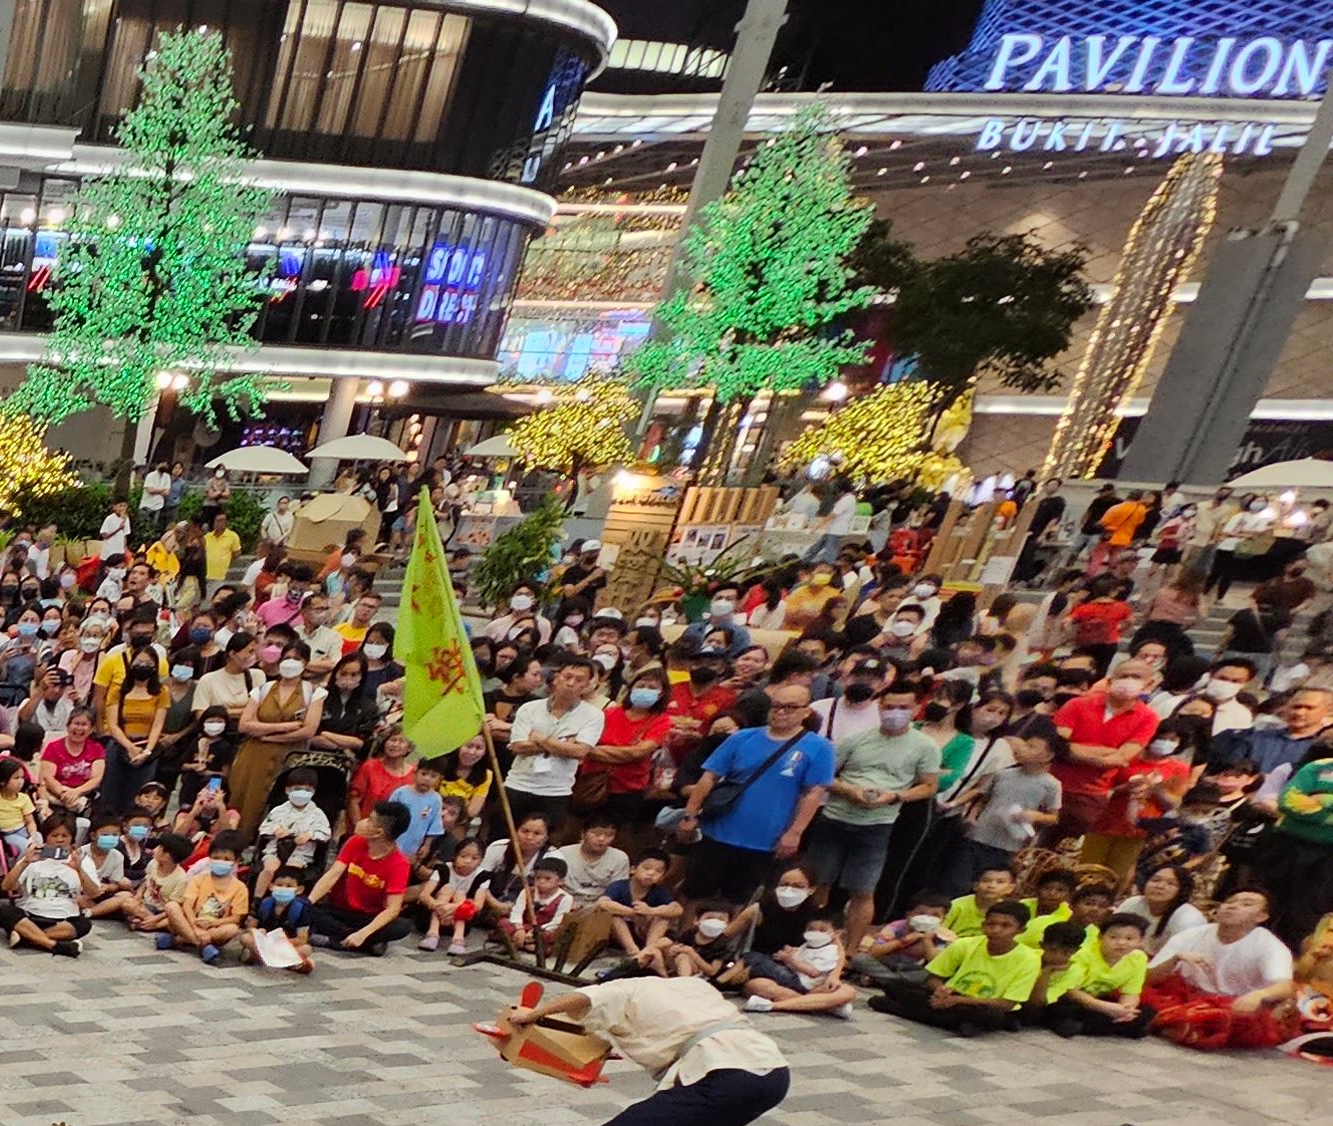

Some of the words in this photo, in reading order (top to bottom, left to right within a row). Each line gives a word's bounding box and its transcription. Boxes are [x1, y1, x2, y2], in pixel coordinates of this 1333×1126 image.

[984, 33, 1333, 96] PAVILION
[976, 117, 1122, 151] BUKIT
[1153, 122, 1276, 158] JALIL
